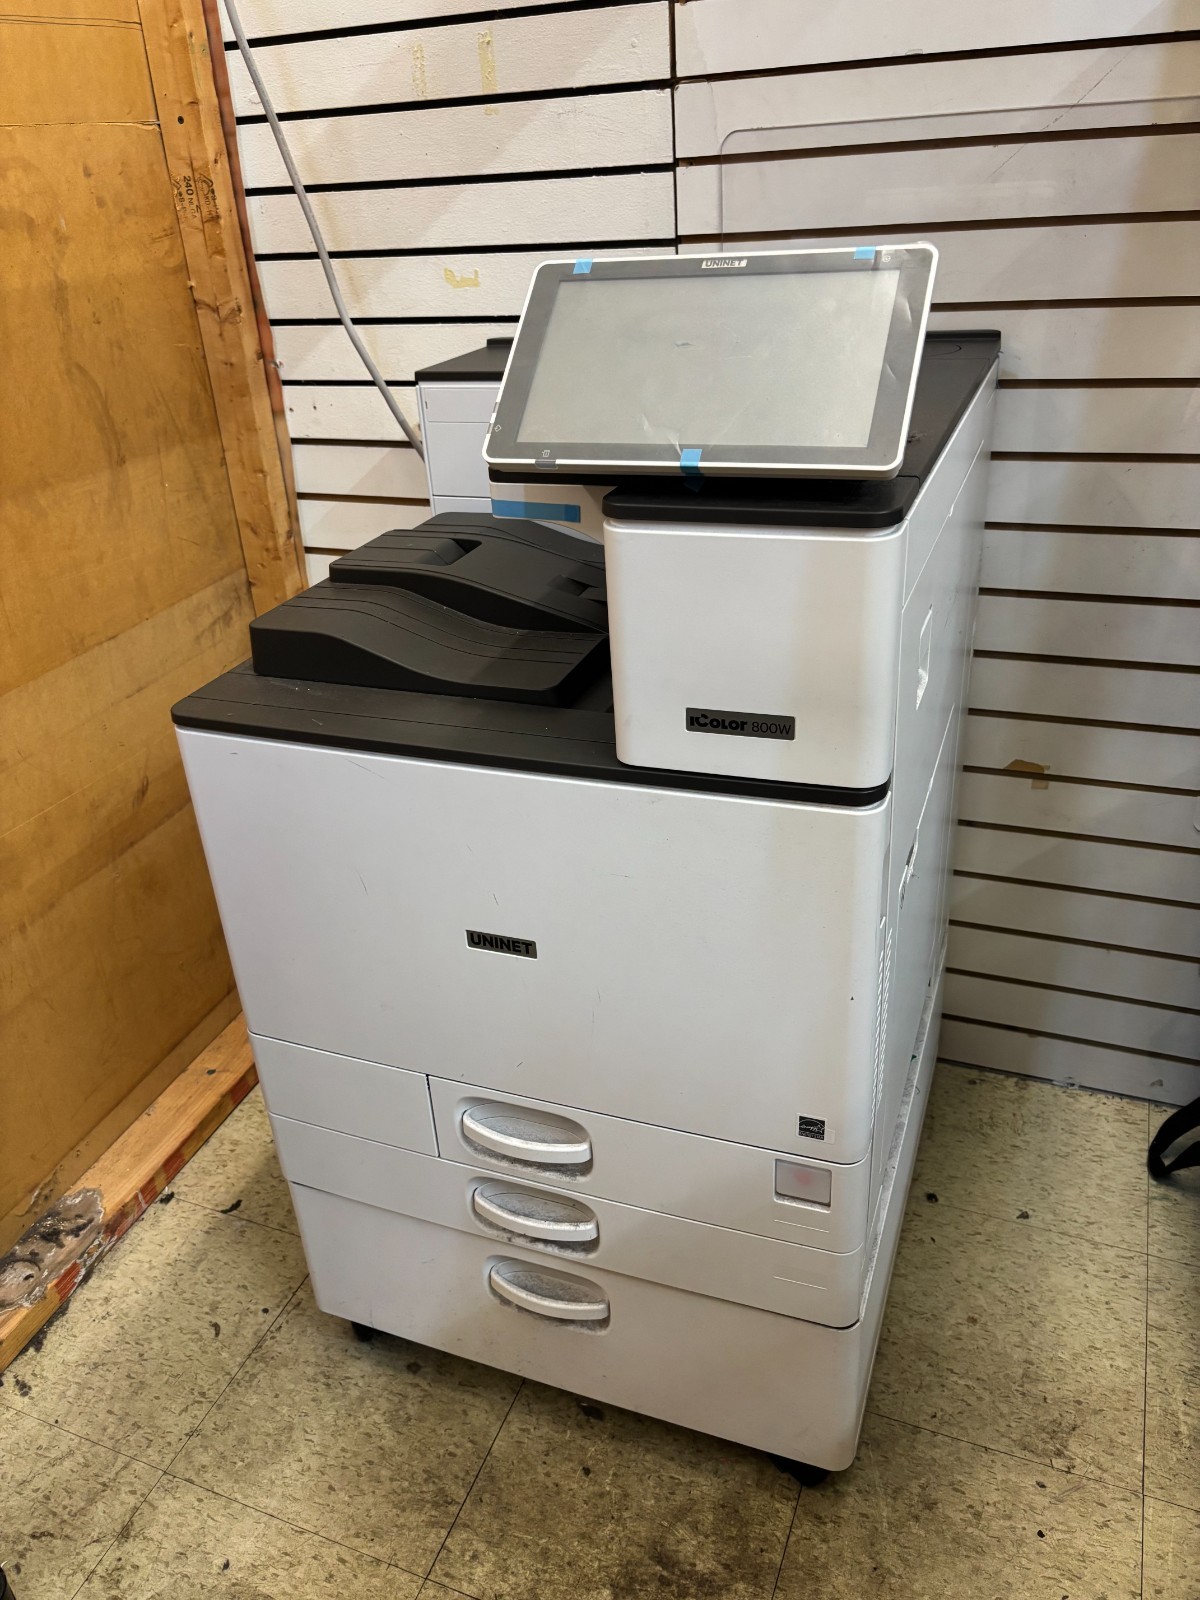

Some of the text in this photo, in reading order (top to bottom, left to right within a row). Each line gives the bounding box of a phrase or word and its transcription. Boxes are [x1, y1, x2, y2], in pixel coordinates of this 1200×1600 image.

[184, 175, 194, 195] 240
[705, 259, 742, 267] UNINET
[751, 721, 792, 735] 800W
[469, 932, 533, 954] UNINET
